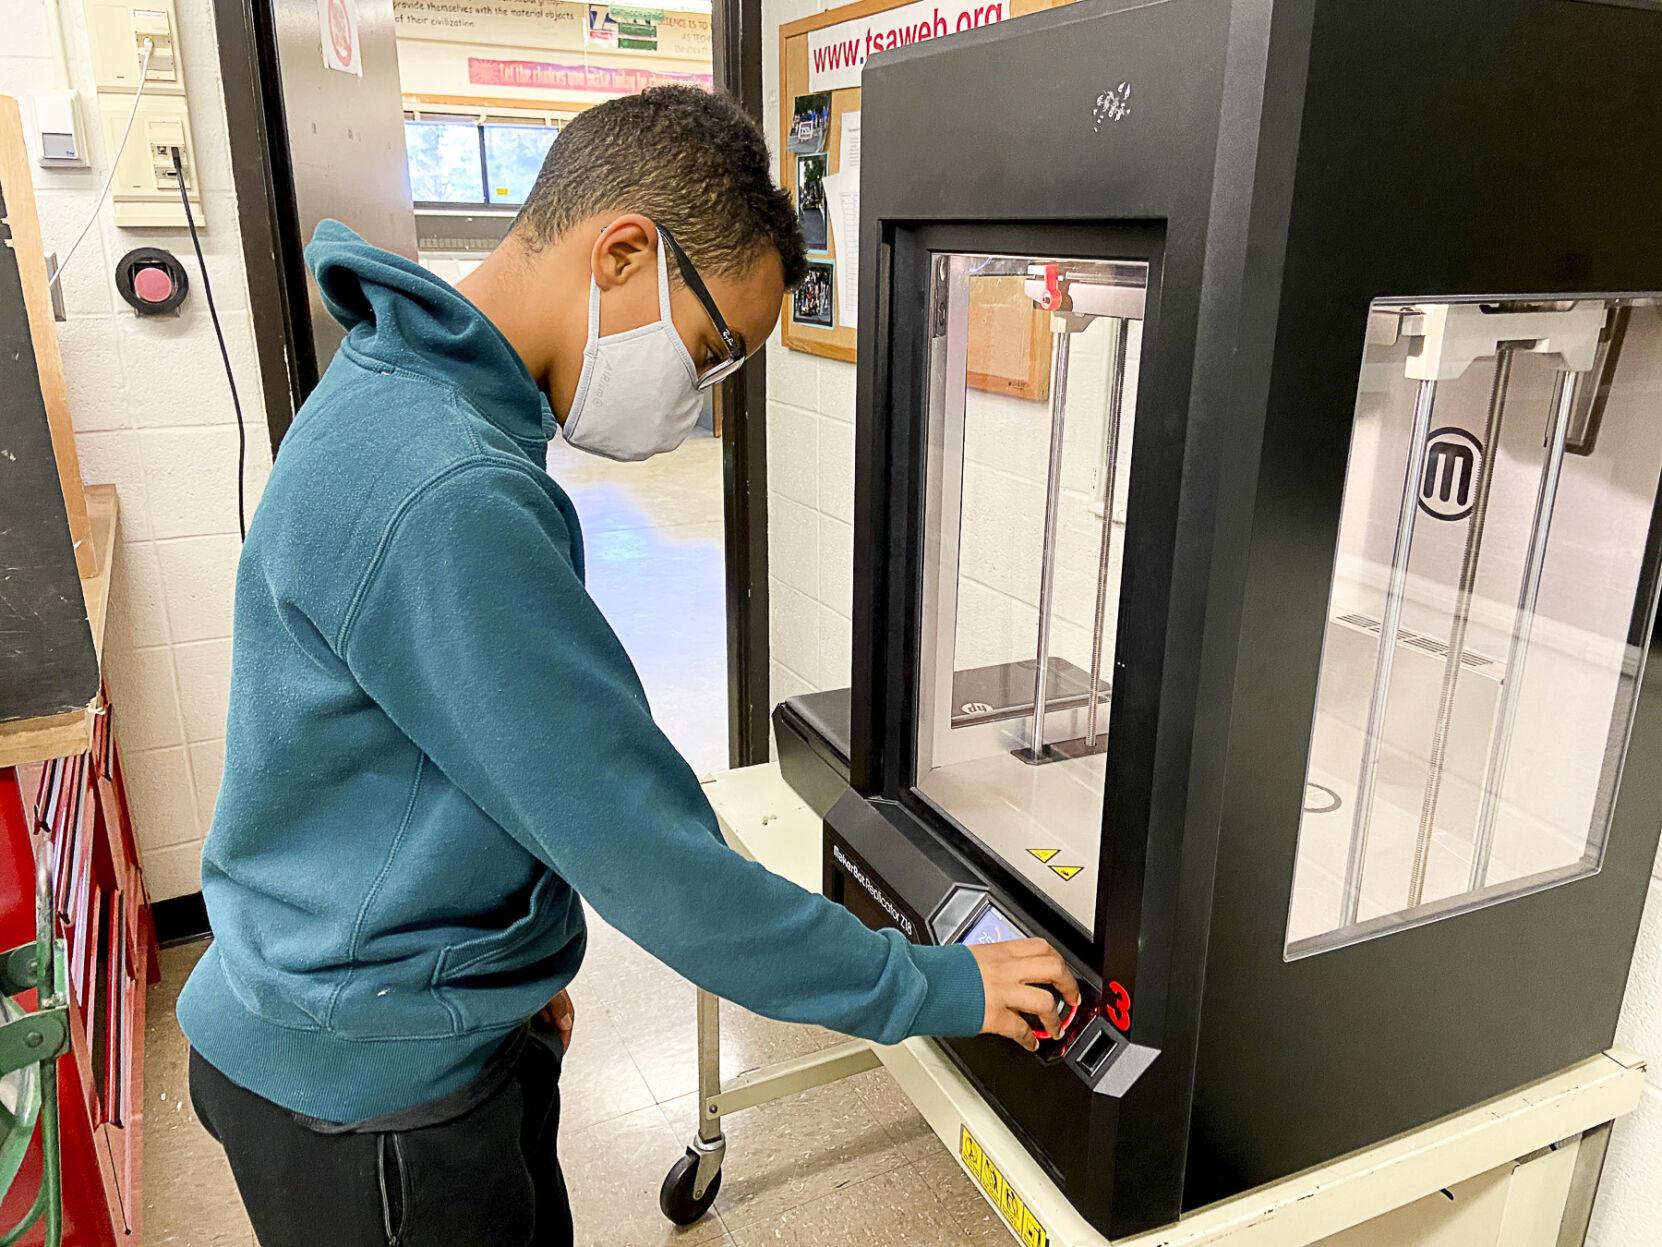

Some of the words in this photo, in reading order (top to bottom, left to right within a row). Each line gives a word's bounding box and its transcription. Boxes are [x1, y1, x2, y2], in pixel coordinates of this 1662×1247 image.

[393, 1, 424, 10] provide
[427, 2, 473, 14] themselves
[475, 6, 492, 15] with
[495, 7, 508, 16] the
[511, 9, 543, 18] material
[545, 11, 575, 21] objects
[394, 14, 404, 23] of
[407, 14, 428, 24] their
[431, 18, 474, 27] civilization
[813, 3, 1002, 73] www.tsaweborg
[833, 844, 866, 887] MakerBot
[865, 877, 900, 922] Replicator
[900, 913, 912, 936] Z18
[1106, 980, 1131, 1031] 3
